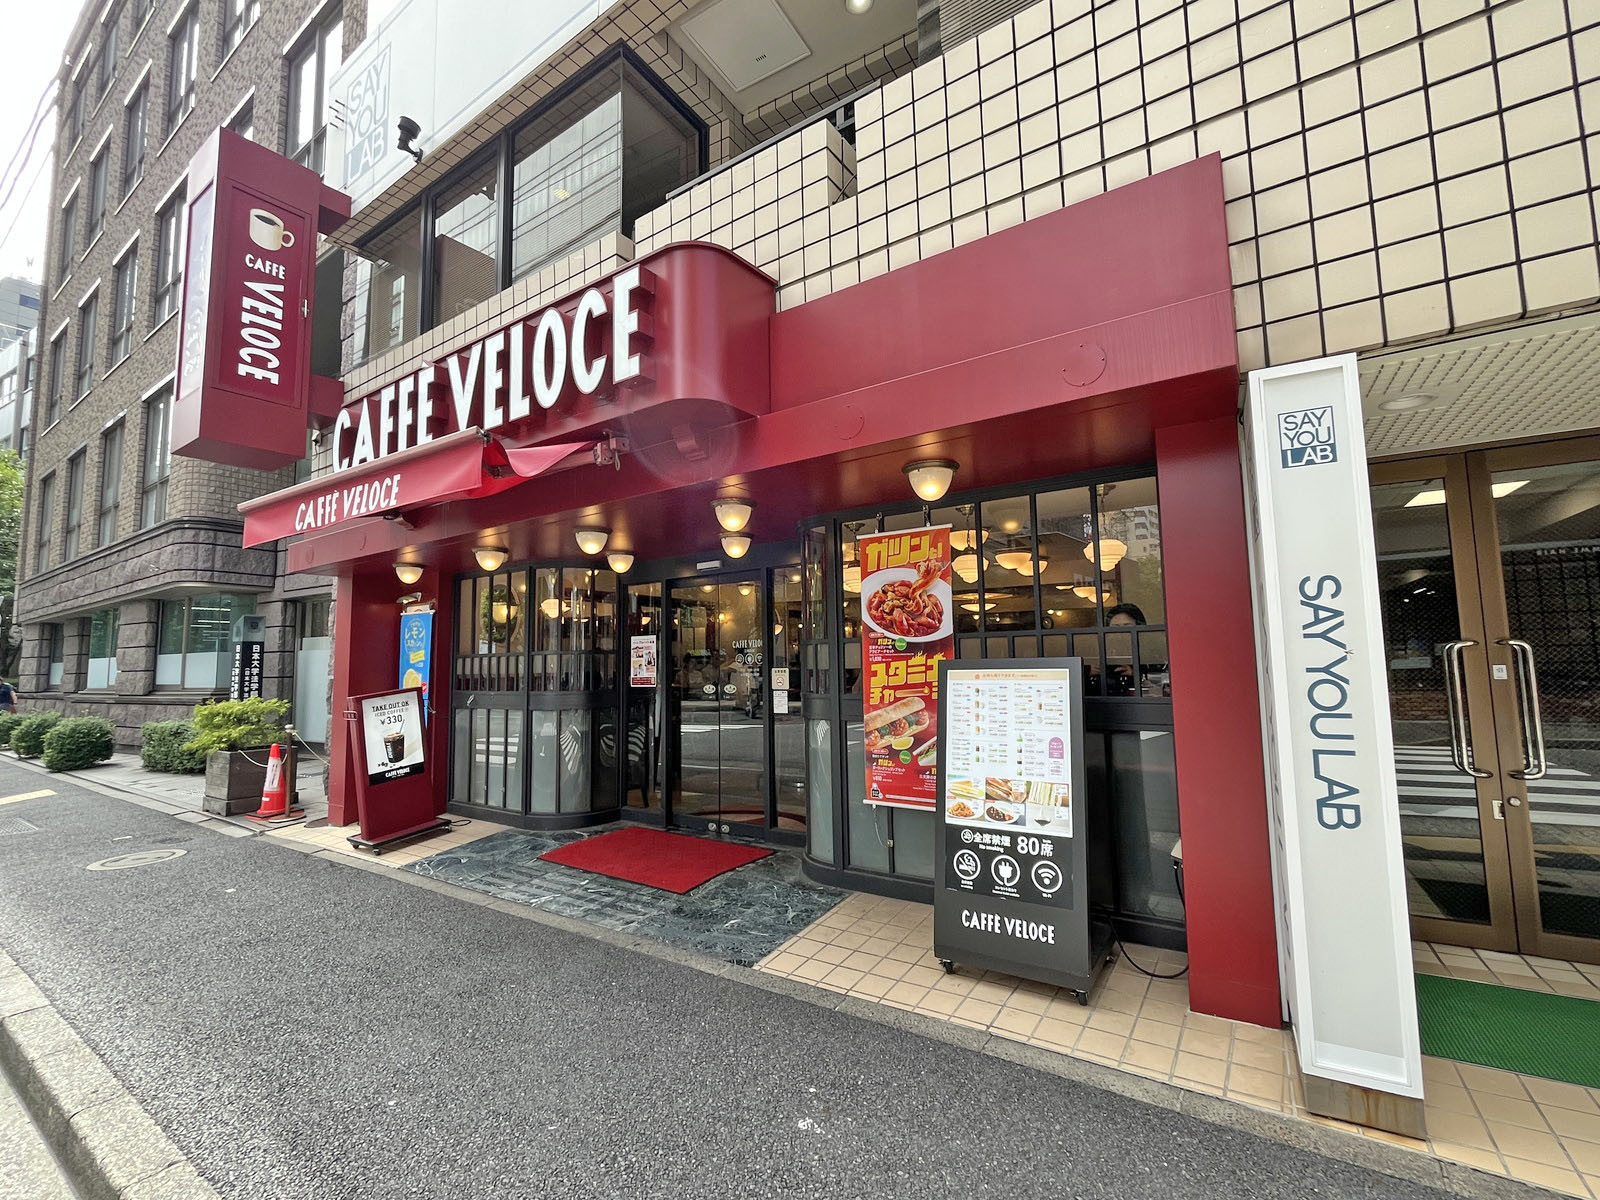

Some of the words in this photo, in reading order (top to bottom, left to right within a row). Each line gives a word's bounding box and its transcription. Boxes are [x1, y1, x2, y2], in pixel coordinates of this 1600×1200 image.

[350, 52, 387, 113] SAY
[347, 85, 387, 147] YOU
[347, 127, 384, 181] LAB
[237, 281, 285, 385] VELOCE
[332, 361, 435, 472] CAFFÈ
[447, 265, 641, 431] VELOCE
[1283, 409, 1327, 431] SAY
[1283, 426, 1331, 447] YOU
[1286, 445, 1333, 467] LAB
[295, 490, 340, 532] CAFFÈ
[343, 473, 401, 521] VELOCE
[1298, 574, 1348, 653] SAY
[372, 703, 387, 713] TAKE
[388, 702, 400, 710] OUT
[1305, 653, 1354, 741] YOU
[1313, 749, 1362, 831] LAB
[961, 909, 1001, 934] CAFFÈ
[1004, 916, 1055, 944] VELOCE
